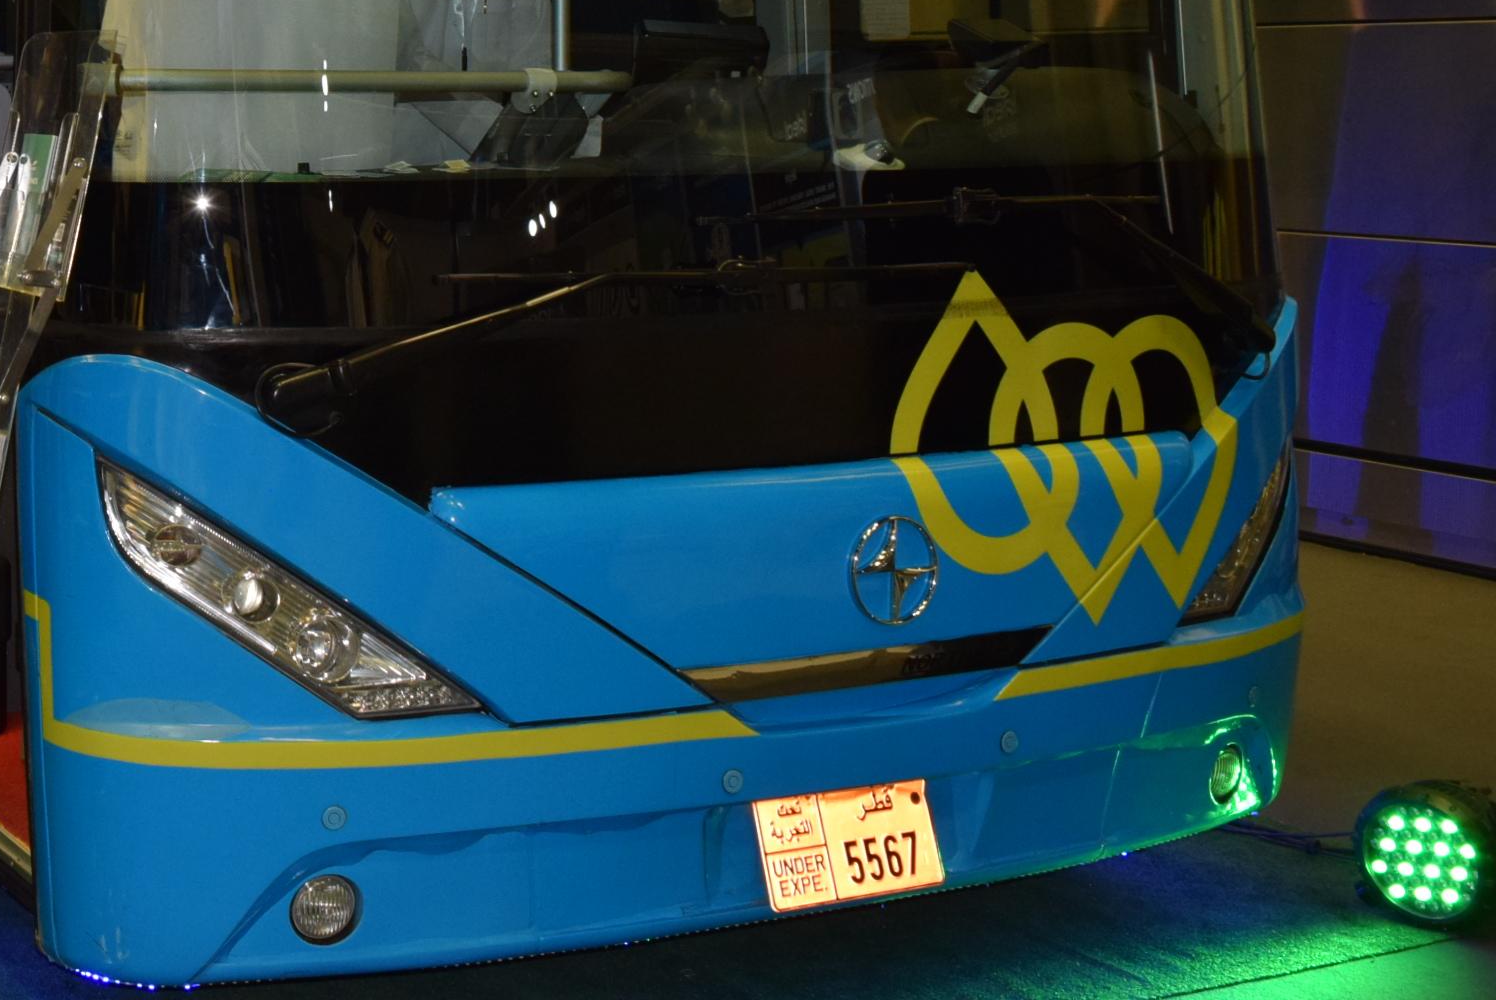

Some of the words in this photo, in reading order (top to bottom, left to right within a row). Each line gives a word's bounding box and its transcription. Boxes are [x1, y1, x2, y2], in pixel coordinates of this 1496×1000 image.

[857, 786, 894, 821] قطر
[772, 853, 827, 878] UNDER
[843, 829, 917, 885] 5567
[778, 873, 828, 898] EXPE.
